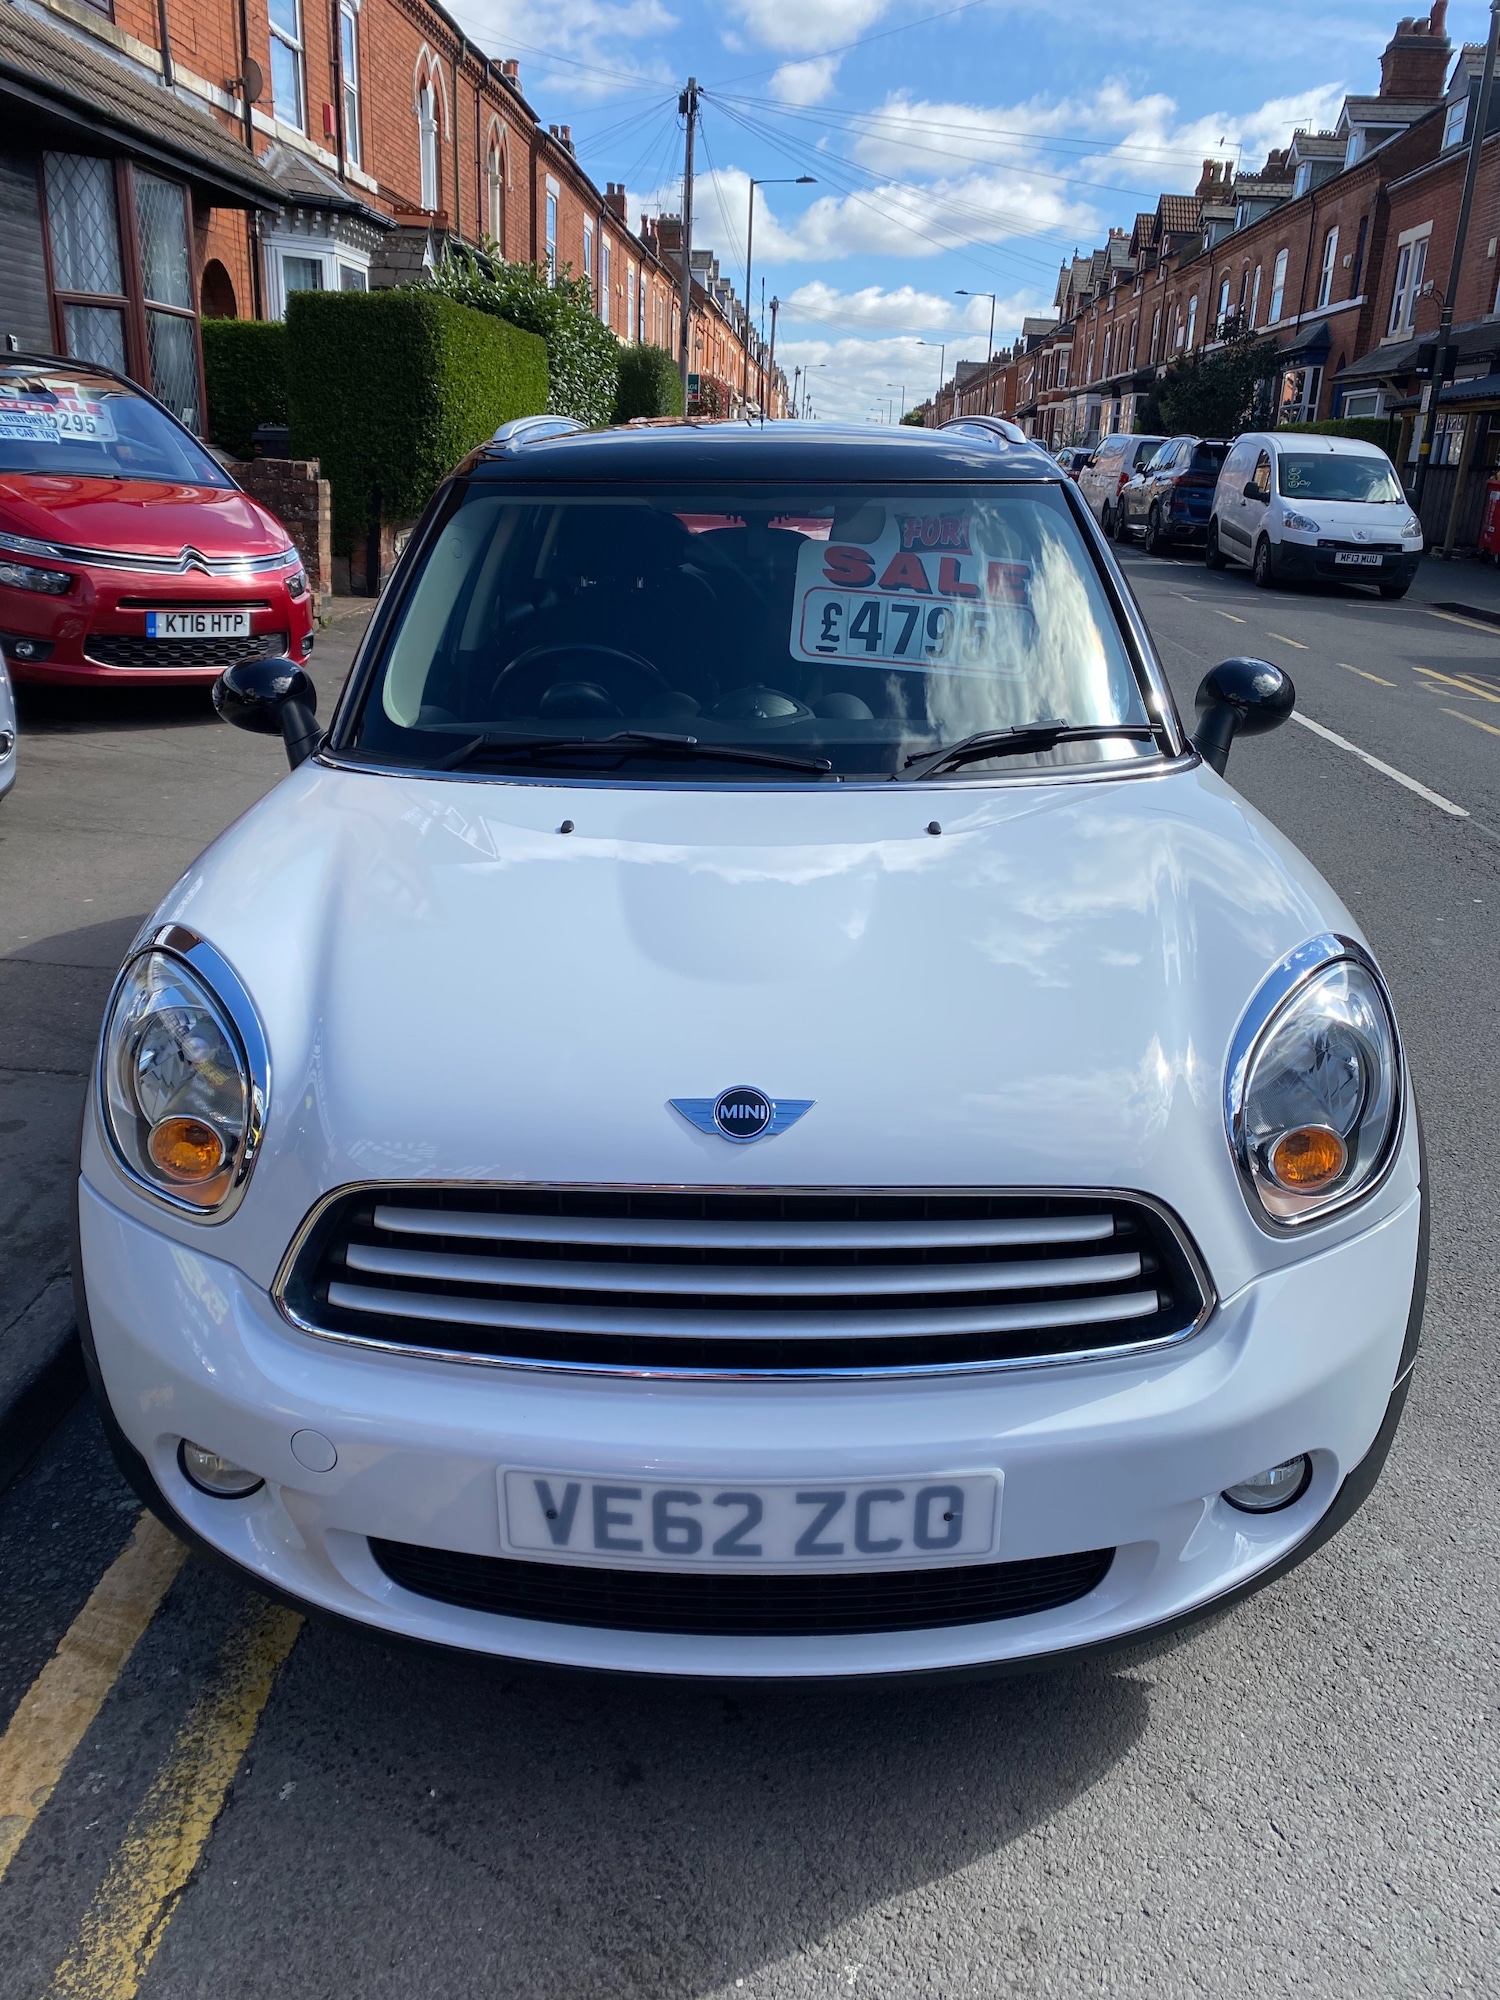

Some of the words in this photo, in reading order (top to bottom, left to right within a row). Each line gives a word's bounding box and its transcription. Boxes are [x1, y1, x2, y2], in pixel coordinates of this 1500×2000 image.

[53, 399, 104, 416] ALE
[2, 414, 44, 425] HISTORY
[16, 428, 37, 439] CAR
[39, 430, 58, 440] TAX
[903, 516, 961, 548] FOR
[1340, 553, 1360, 563] MF13
[822, 545, 1033, 606] SALE
[165, 614, 206, 633] KT16
[211, 614, 244, 632] HTP
[820, 600, 991, 662] £4795
[720, 1104, 766, 1120] MINI
[533, 1479, 763, 1557] VE62
[794, 1484, 965, 1556] ZCO
